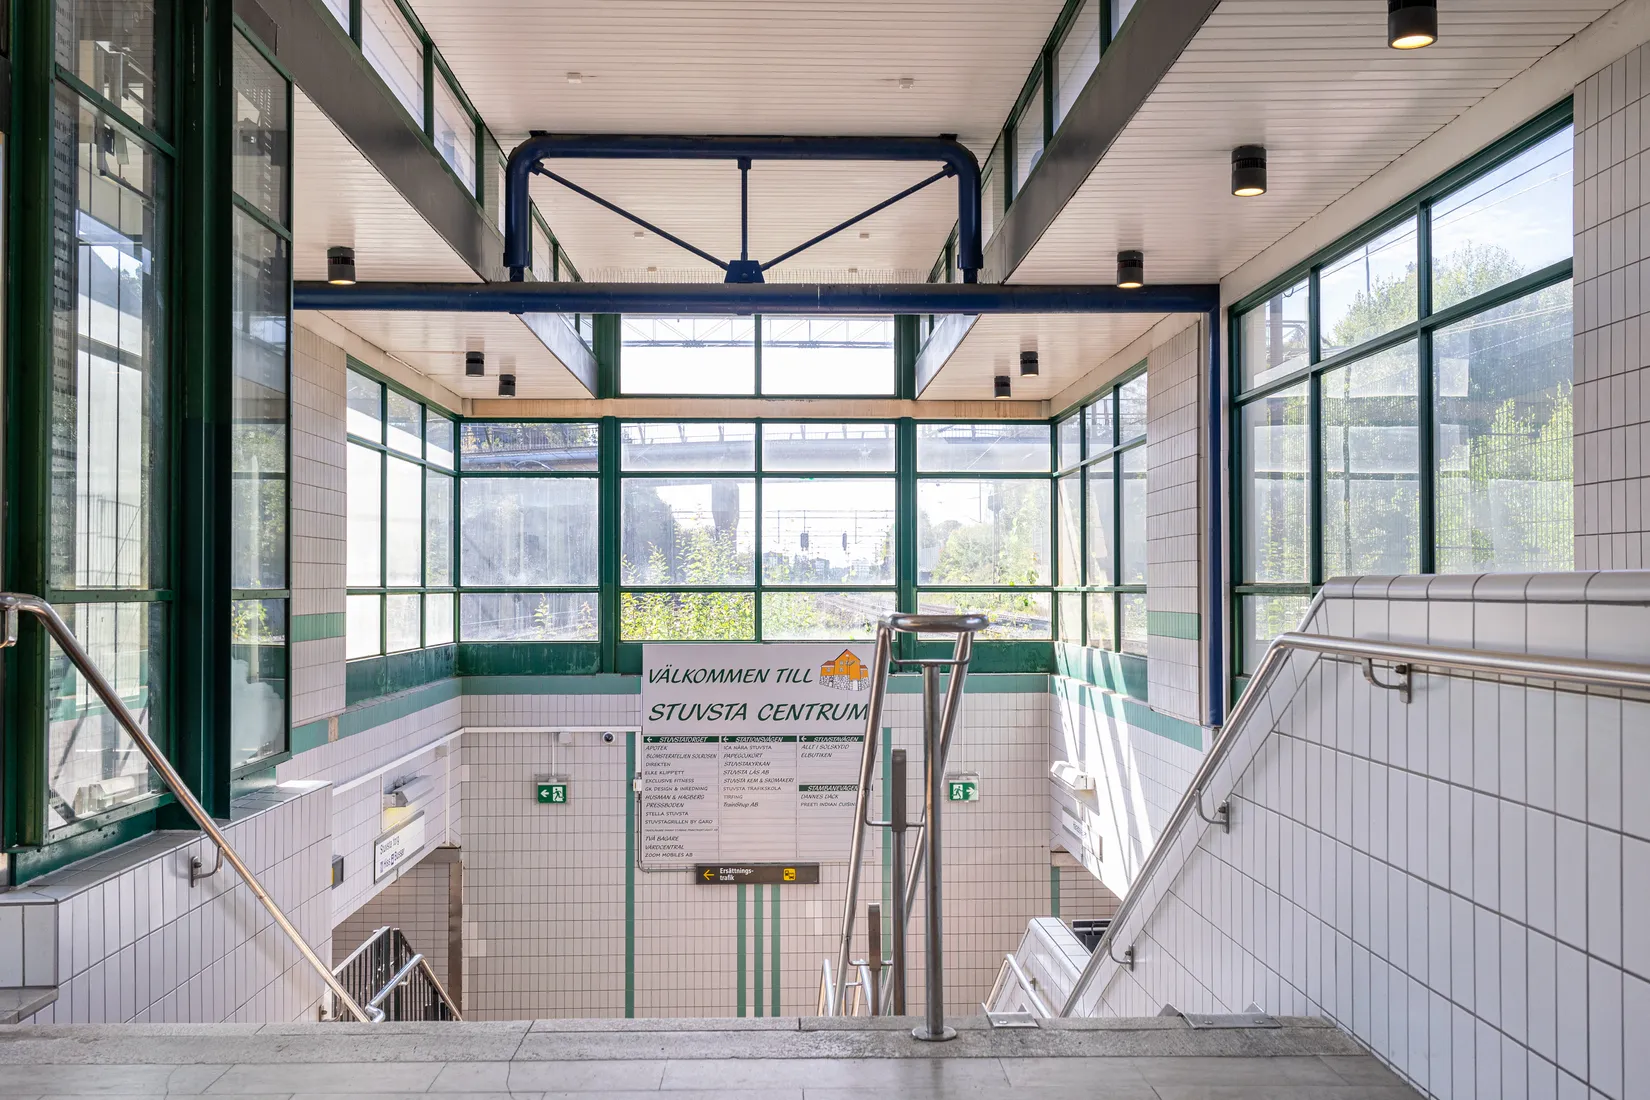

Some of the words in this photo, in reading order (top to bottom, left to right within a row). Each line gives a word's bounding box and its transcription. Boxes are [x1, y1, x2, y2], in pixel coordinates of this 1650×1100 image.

[649, 664, 771, 684] VÄLKOMMEN
[776, 668, 813, 684] TILL
[648, 702, 748, 721] STUVSTA
[757, 702, 868, 721] CENTRUM
[719, 867, 754, 876] Ersättnings-
